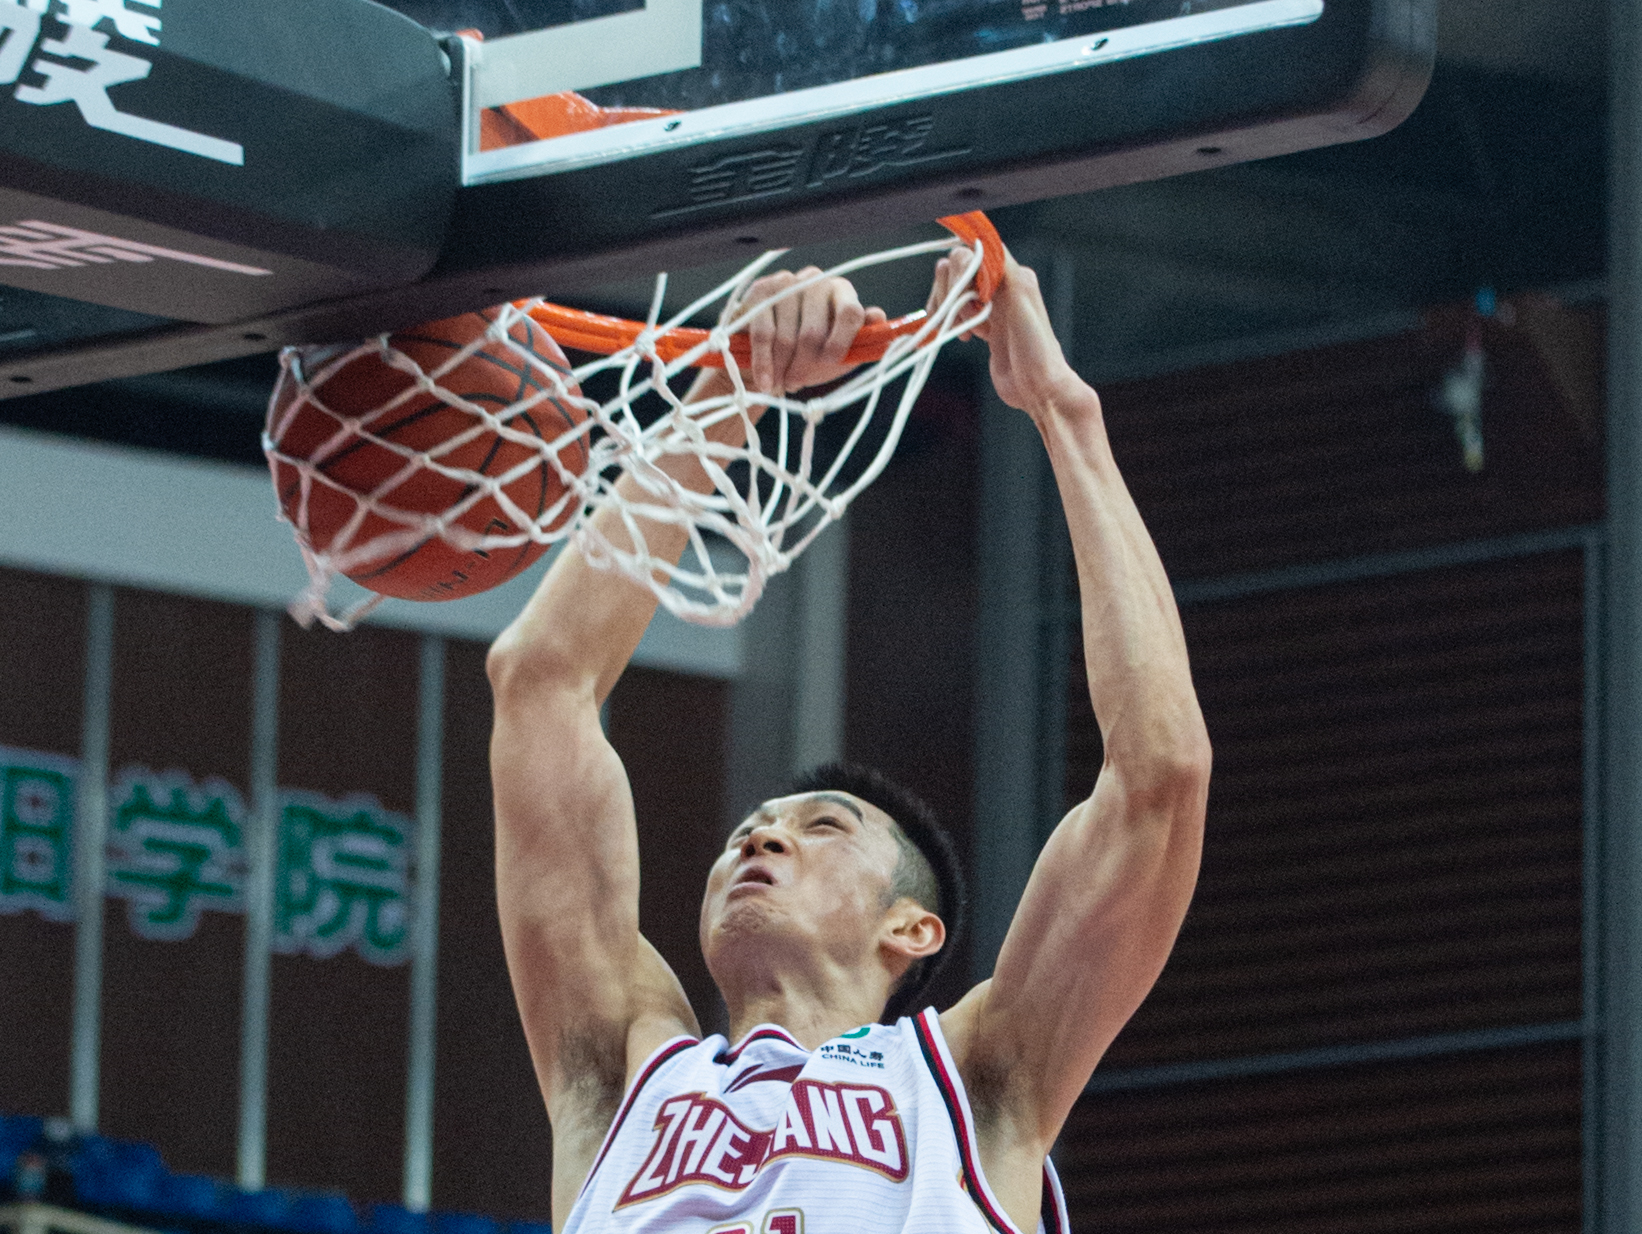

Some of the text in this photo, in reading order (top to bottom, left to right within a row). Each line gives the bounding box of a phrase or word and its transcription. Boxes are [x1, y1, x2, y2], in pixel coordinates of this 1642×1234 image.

[821, 1054, 885, 1069] CHINA LIFE
[627, 1083, 904, 1198] ZHEANG
